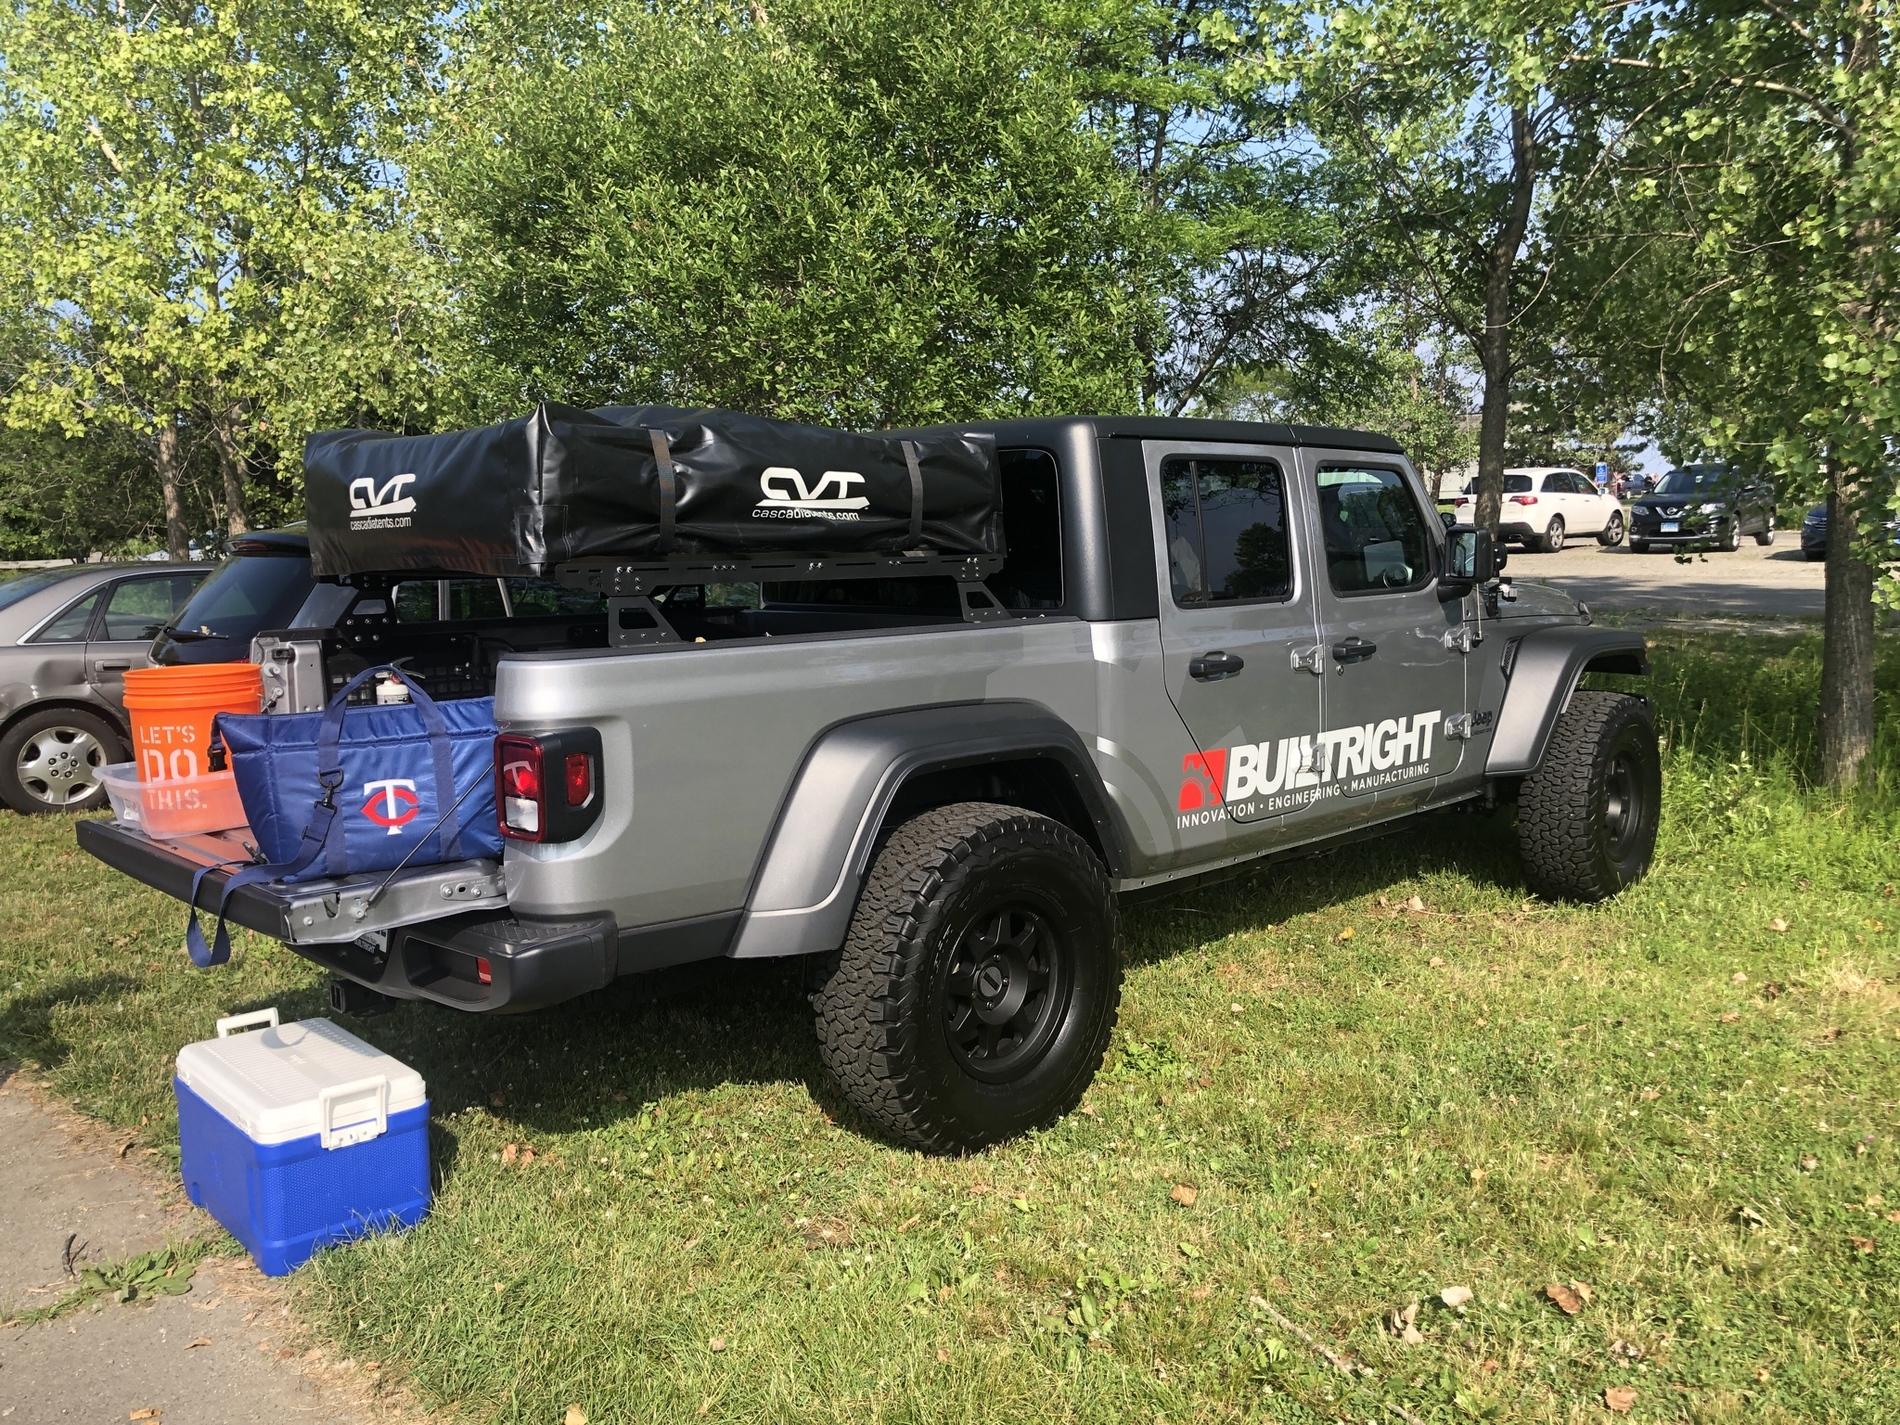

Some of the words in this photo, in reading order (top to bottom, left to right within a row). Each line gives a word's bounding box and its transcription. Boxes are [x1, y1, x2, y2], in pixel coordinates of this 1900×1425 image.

[349, 515, 412, 531] cascadiatents.com
[140, 724, 196, 745] LET'S
[142, 748, 199, 786] DO
[1225, 709, 1442, 802] BUILTRIGHT
[147, 788, 209, 811] THIS.
[1176, 801, 1255, 830] INNOVATION
[1268, 783, 1341, 812] ENGINEERING
[1350, 762, 1430, 792] MANUFACTURING
